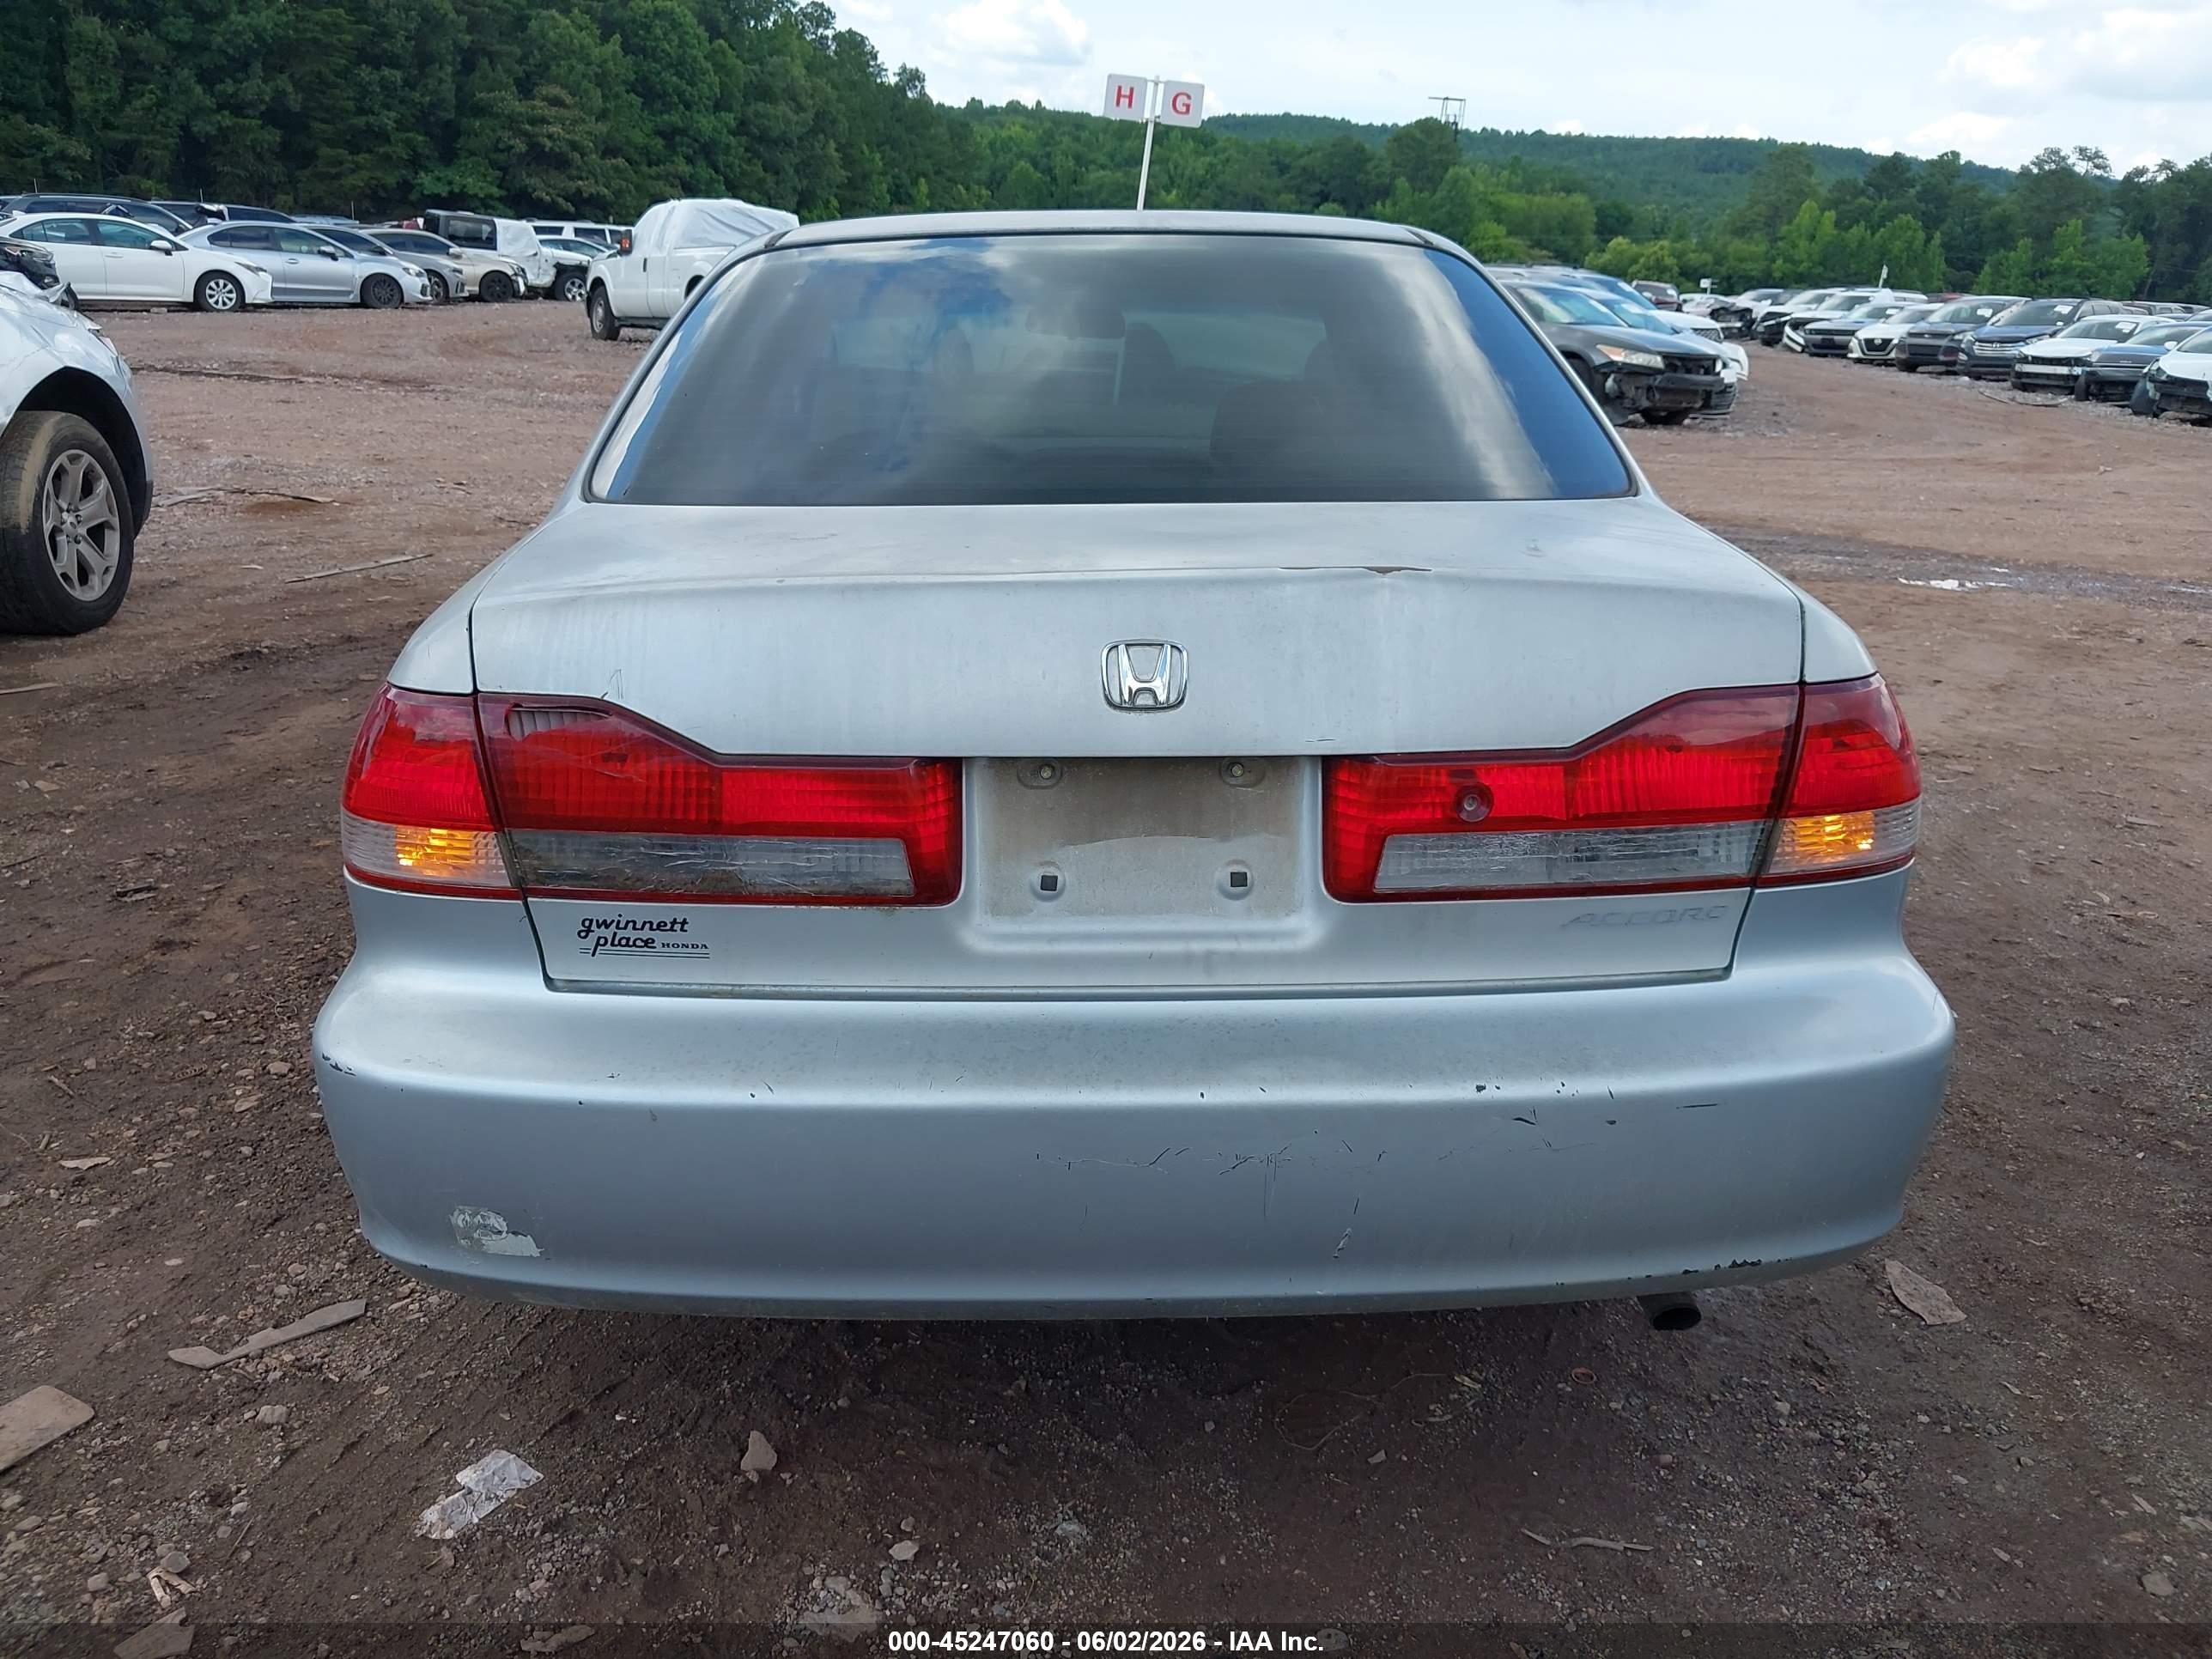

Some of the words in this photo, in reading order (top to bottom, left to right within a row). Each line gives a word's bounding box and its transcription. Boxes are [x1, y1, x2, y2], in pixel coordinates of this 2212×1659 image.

[1115, 84, 1134, 109] H
[1171, 91, 1192, 116] G
[577, 914, 690, 939] gwinnett
[591, 932, 657, 957] place
